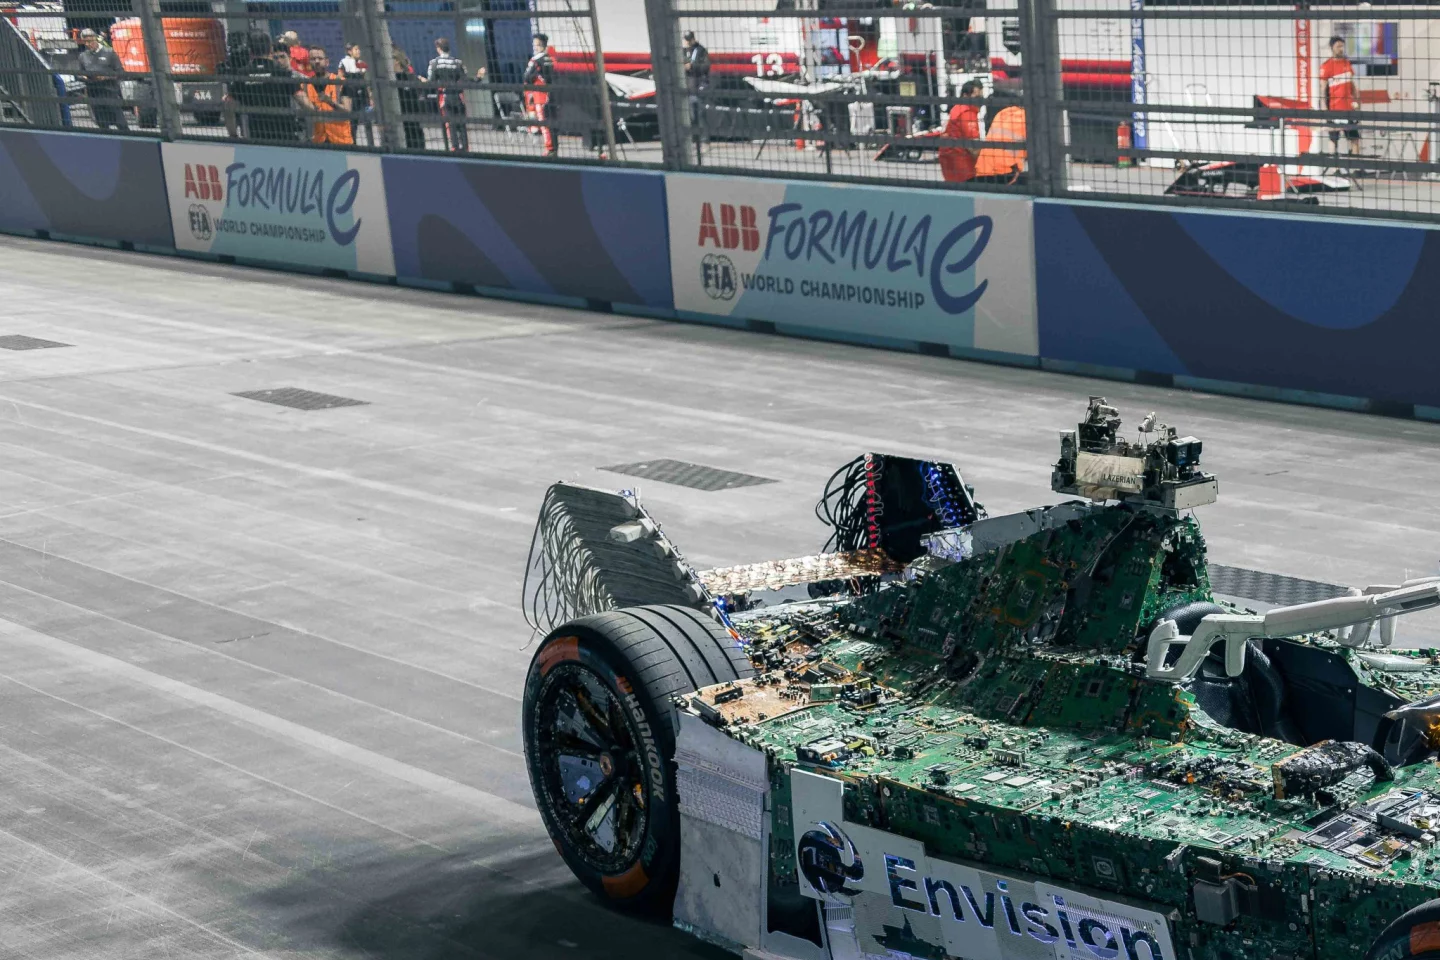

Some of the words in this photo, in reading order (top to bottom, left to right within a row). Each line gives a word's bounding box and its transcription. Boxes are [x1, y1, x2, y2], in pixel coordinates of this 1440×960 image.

[751, 53, 784, 77] 13
[184, 163, 222, 201] ABB
[225, 162, 324, 218] FORMULA
[213, 217, 247, 236] WORLD
[250, 222, 326, 244] CHAMPIONSHIP
[698, 201, 760, 252] ABB
[763, 202, 933, 278] FORMULA
[740, 272, 795, 296] WORLD
[799, 280, 926, 310] CHAMPIONSHIP
[1103, 473, 1136, 484] LAZERIAN
